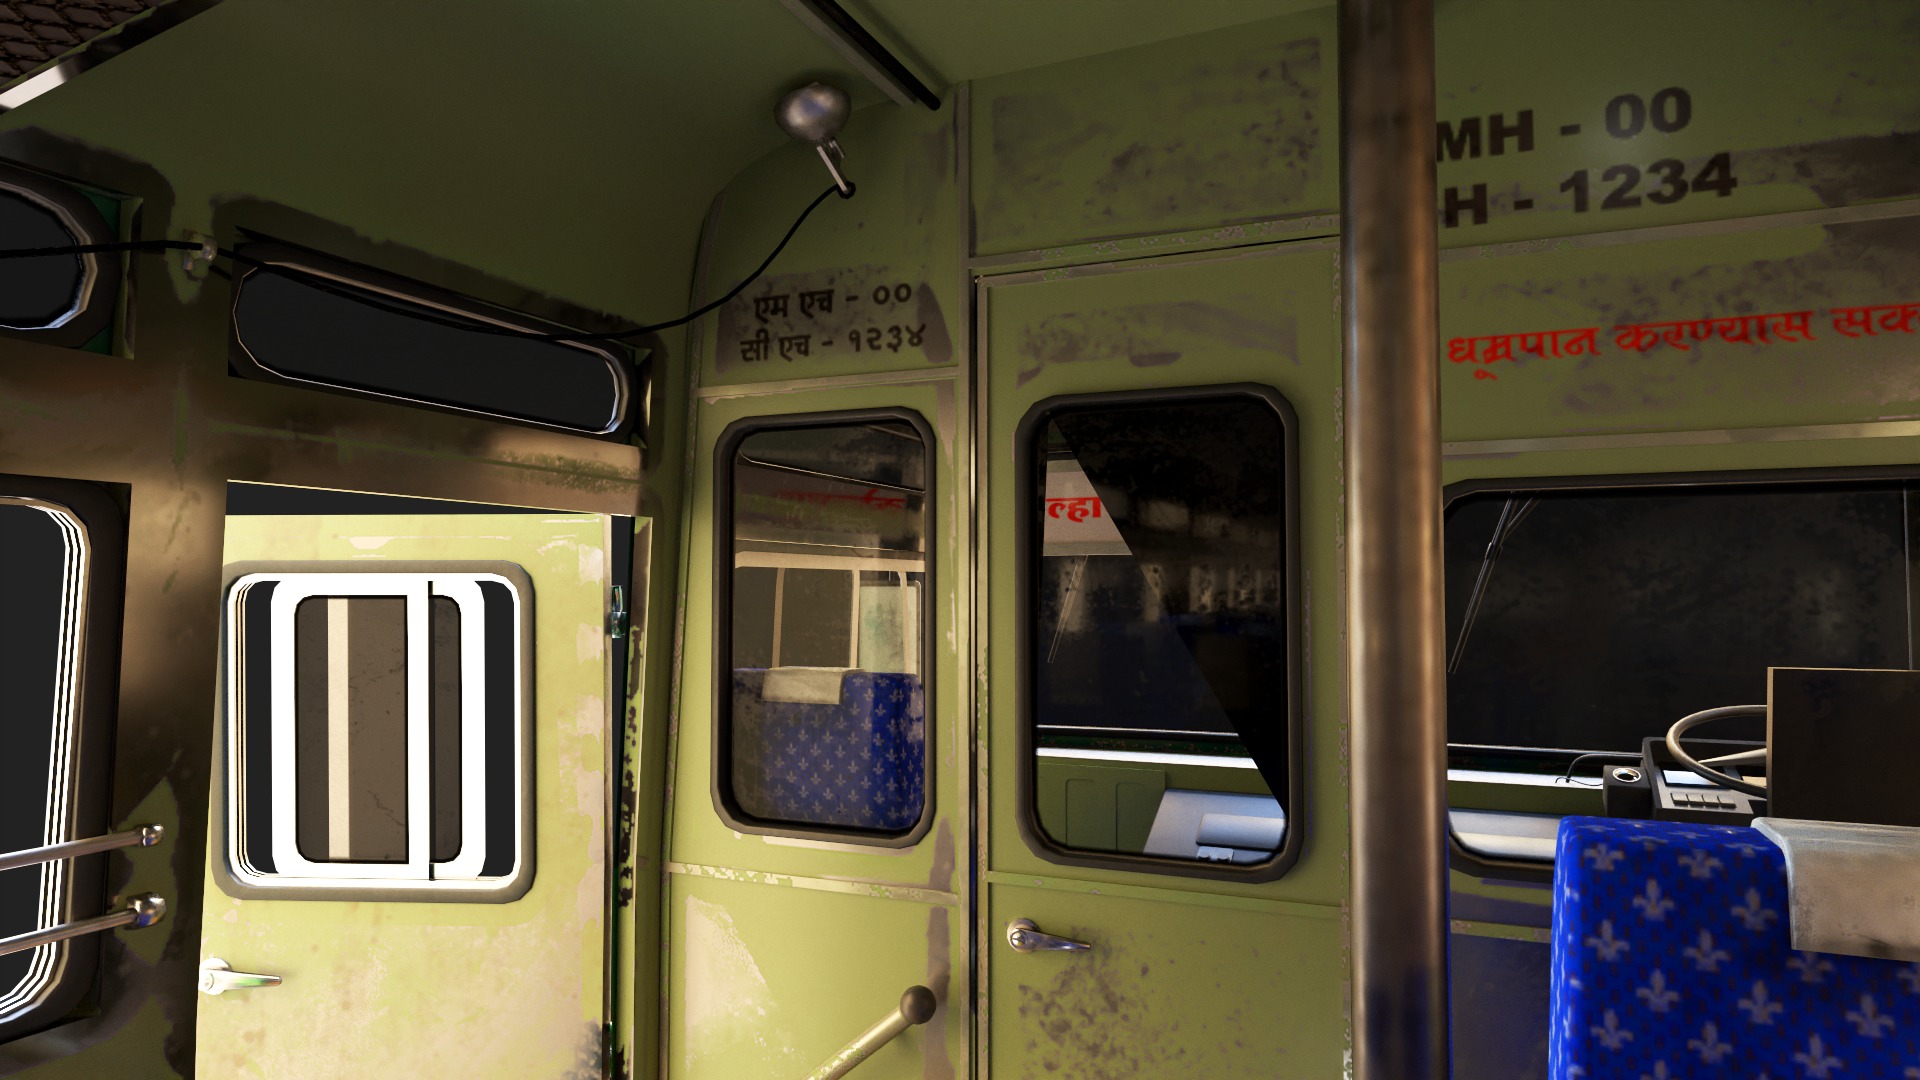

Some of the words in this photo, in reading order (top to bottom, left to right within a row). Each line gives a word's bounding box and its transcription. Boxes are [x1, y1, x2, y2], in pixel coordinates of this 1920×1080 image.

[1436, 109, 1534, 163] MH
[1605, 86, 1692, 139] 00
[1559, 152, 1738, 213] 1234
[754, 294, 789, 324] एम
[799, 289, 834, 319] एच
[740, 328, 770, 362] सी
[778, 334, 811, 362] एच
[848, 323, 927, 352] १२३४
[1612, 310, 1818, 352] करण्यास
